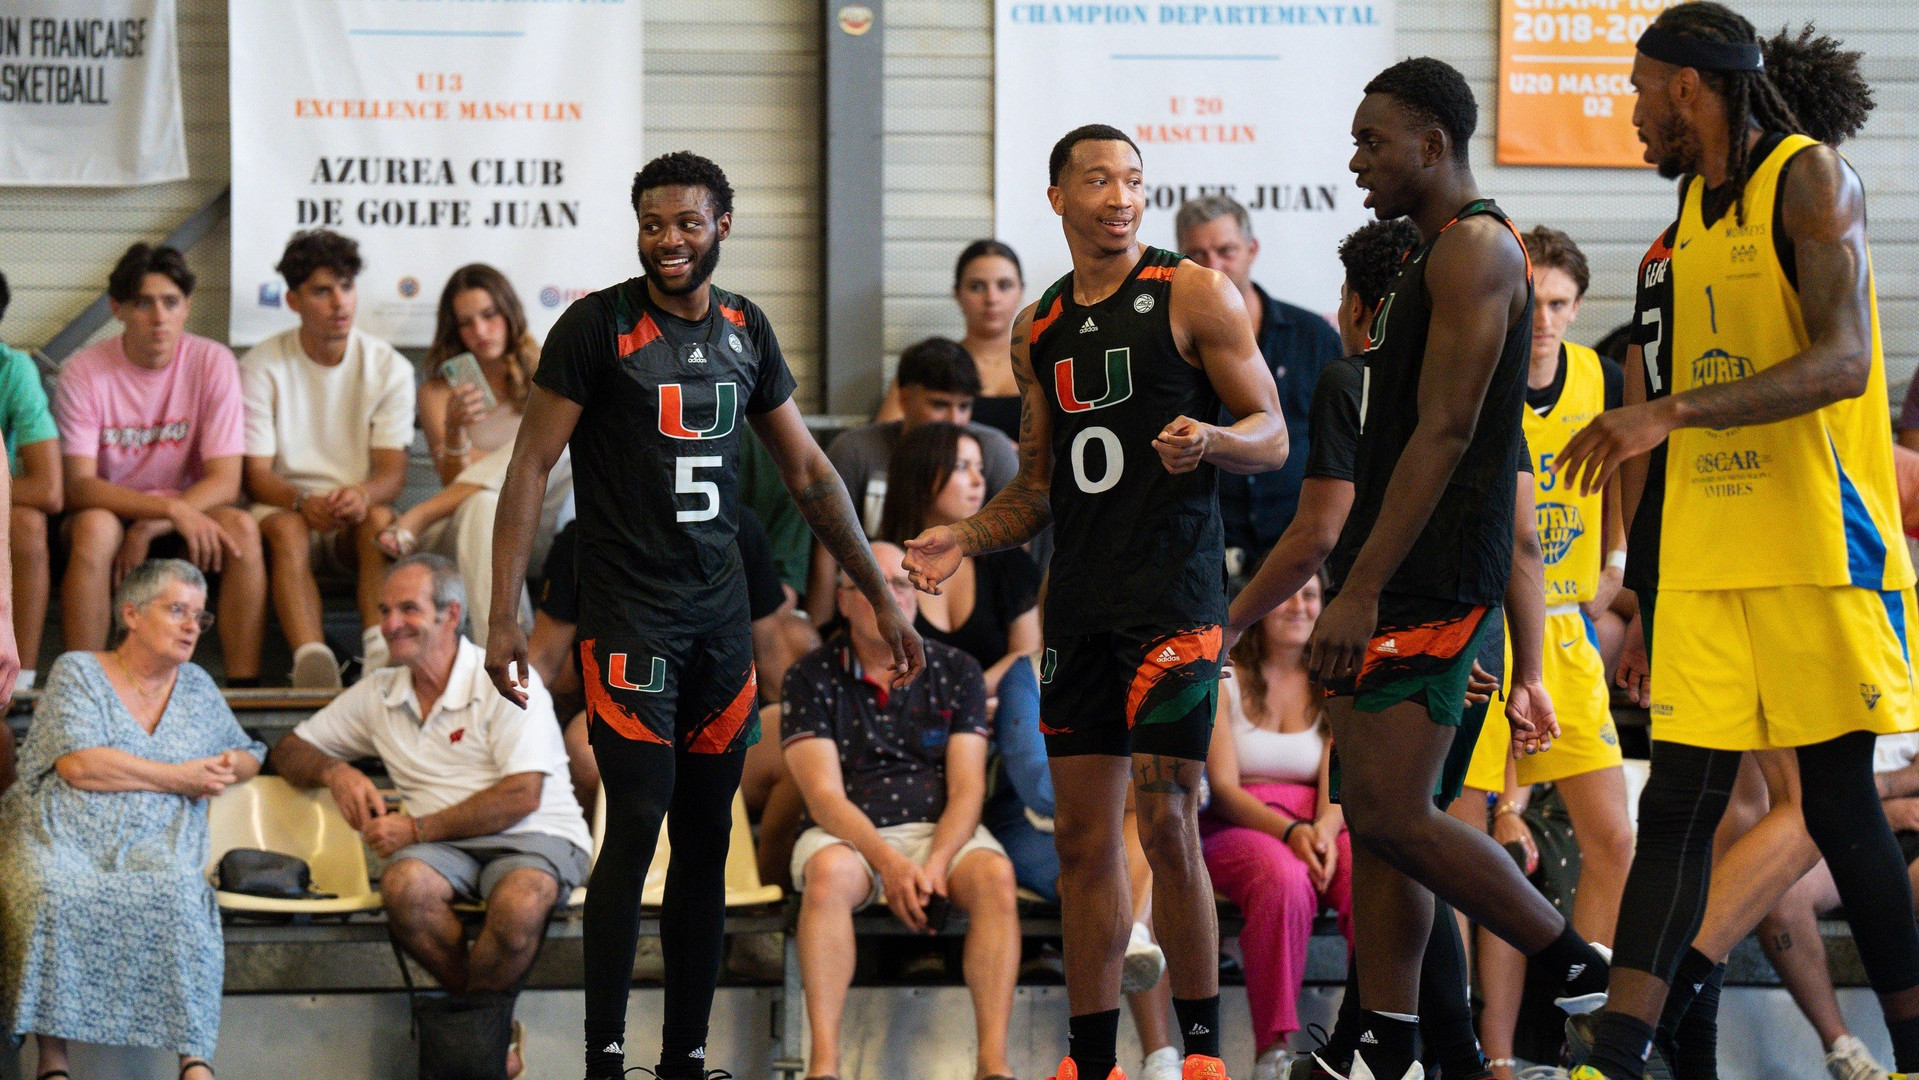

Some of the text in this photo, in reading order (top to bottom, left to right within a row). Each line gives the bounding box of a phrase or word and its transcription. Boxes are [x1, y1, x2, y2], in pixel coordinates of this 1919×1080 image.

[1011, 4, 1379, 25] CHAMPION DEPARTEMENTAL
[1513, 13, 1656, 43] 2018-20
[416, 71, 464, 92] U13
[1509, 73, 1636, 96] U20 MASCU
[295, 98, 583, 121] EXCELLENCE MASCULIN
[1170, 97, 1223, 115] U 20
[1583, 96, 1613, 117] D2
[1136, 125, 1257, 143] MASCULIN
[311, 157, 565, 187] AZUREA CLUB
[1251, 183, 1338, 211] JUAN
[297, 199, 580, 228] DE GOLFE JUAN
[1705, 285, 1718, 334] 1
[1053, 346, 1134, 415] U
[658, 382, 738, 440] U
[1070, 426, 1125, 494] 0
[1539, 453, 1556, 491] 5
[675, 456, 723, 523] 5
[608, 652, 666, 693] U
[1156, 655, 1180, 663] adidas
